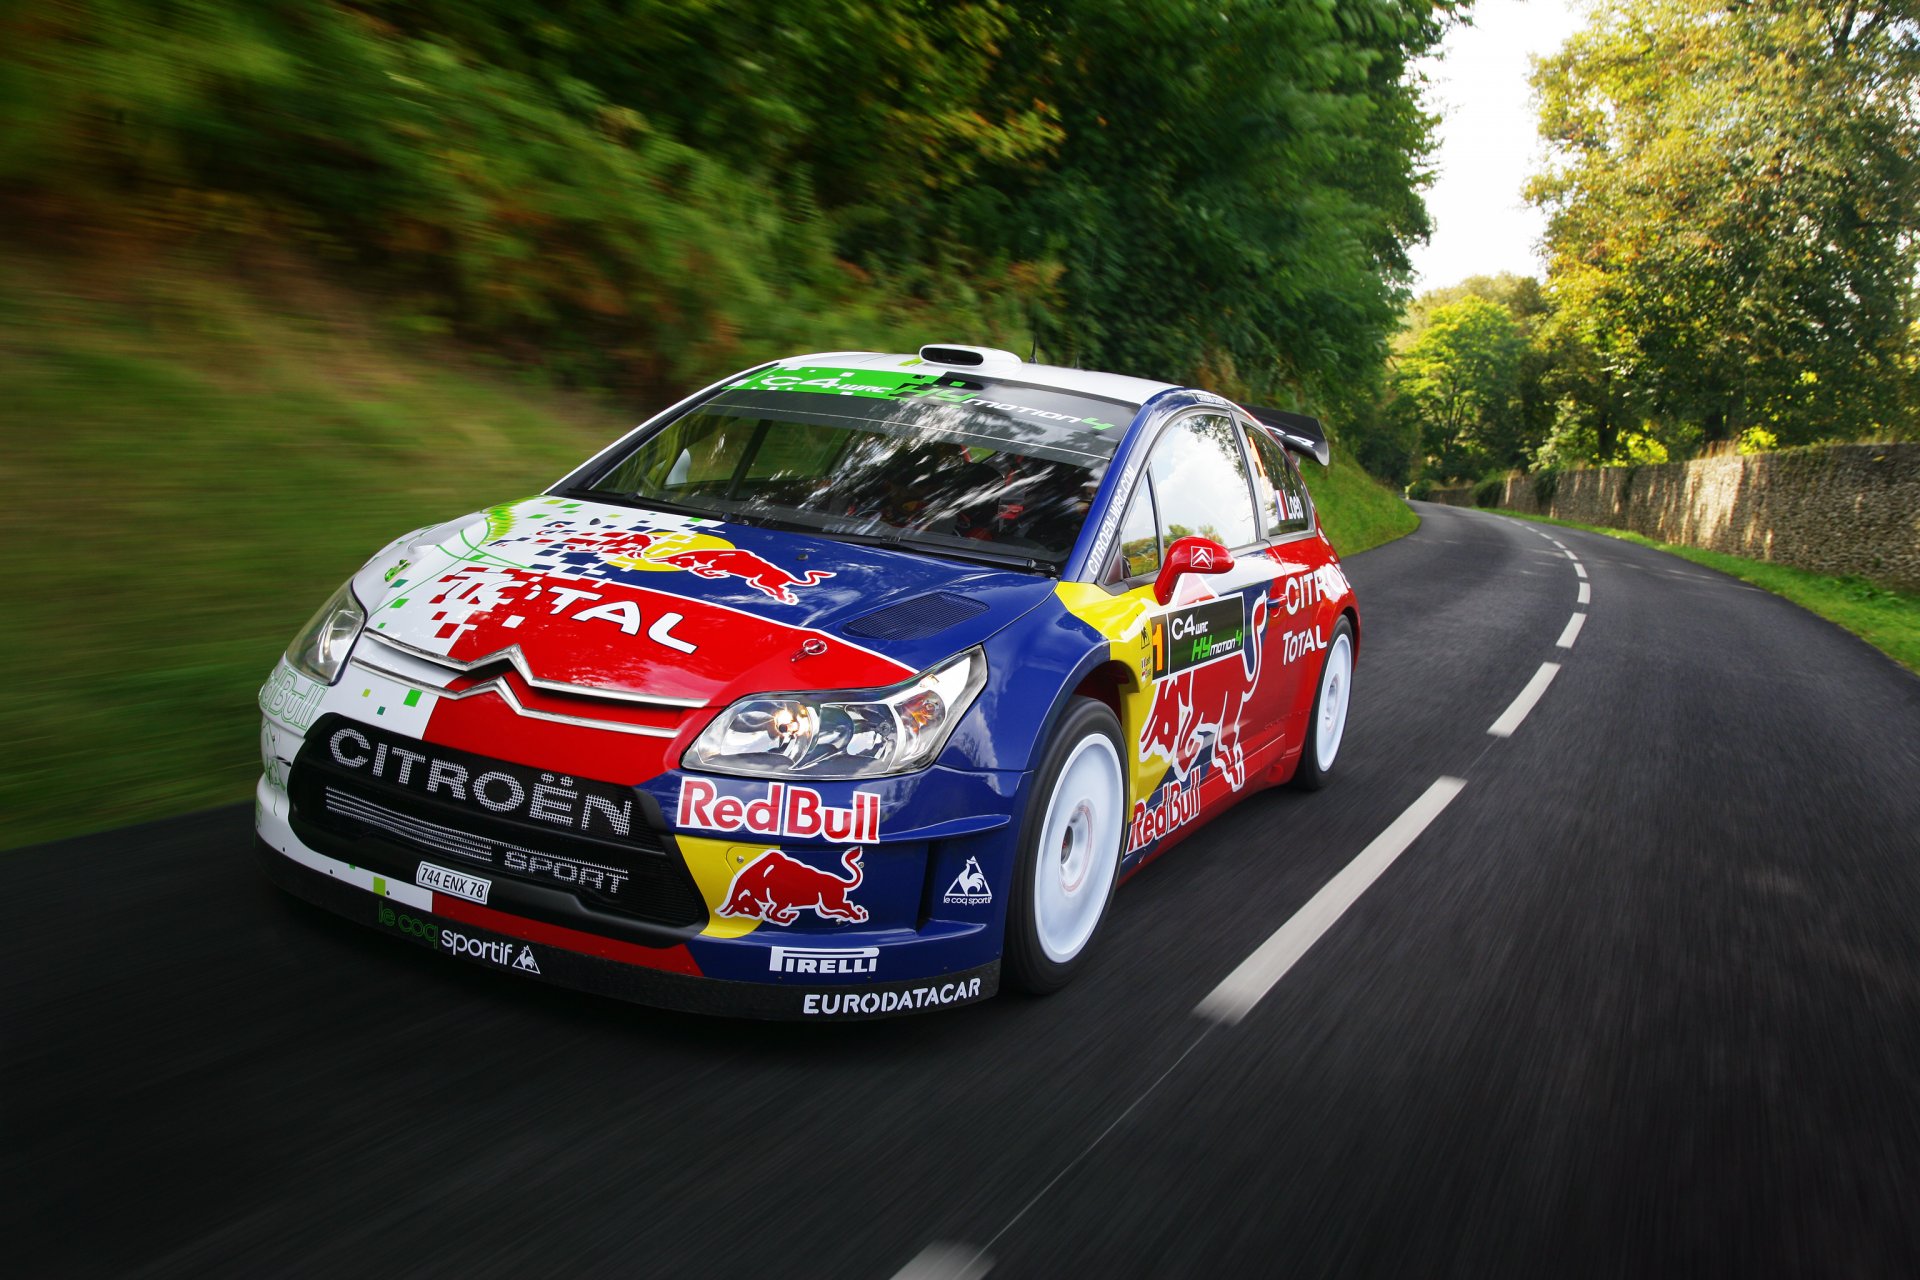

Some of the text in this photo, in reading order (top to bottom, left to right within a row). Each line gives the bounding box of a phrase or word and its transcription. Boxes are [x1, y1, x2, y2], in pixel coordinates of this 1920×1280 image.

[1171, 613, 1195, 640] C4
[329, 727, 633, 836] CITROËN
[677, 776, 881, 844] Red Bull
[1126, 765, 1200, 853] Red Bull
[420, 867, 485, 899] 744 ENX 78
[504, 849, 630, 893] SPORT
[441, 929, 513, 966] sportif
[769, 946, 880, 974] PIRELLI
[803, 977, 981, 1015] EURODATACAR
